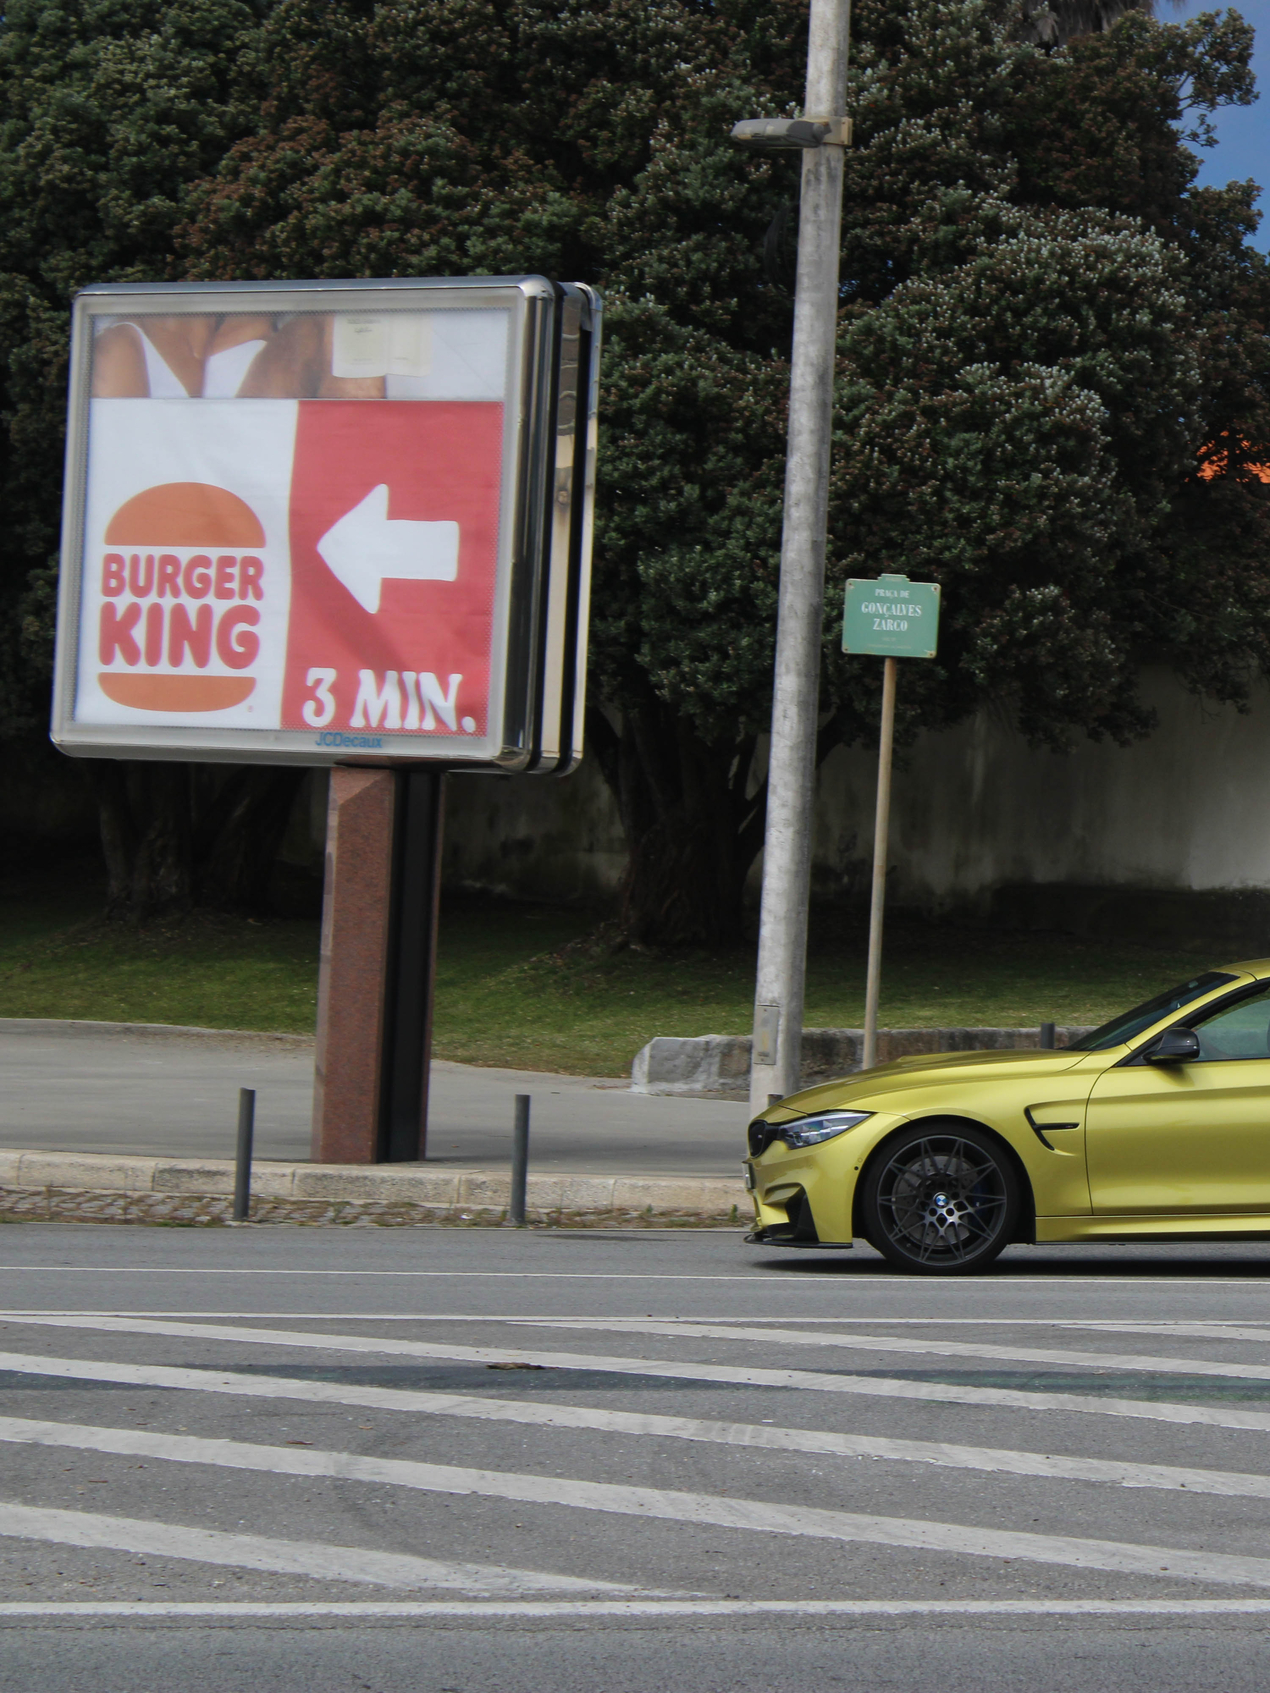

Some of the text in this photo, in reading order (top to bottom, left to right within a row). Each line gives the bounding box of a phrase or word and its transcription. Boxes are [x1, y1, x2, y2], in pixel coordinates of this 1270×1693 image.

[103, 553, 264, 600] BURGER
[875, 588, 910, 599] PRAÇA DE
[861, 602, 922, 617] GONÇALVES
[873, 618, 908, 631] ZARCO
[100, 601, 261, 669] KING
[302, 667, 476, 733] 3 MIN.
[315, 732, 382, 748] JCDecaux
